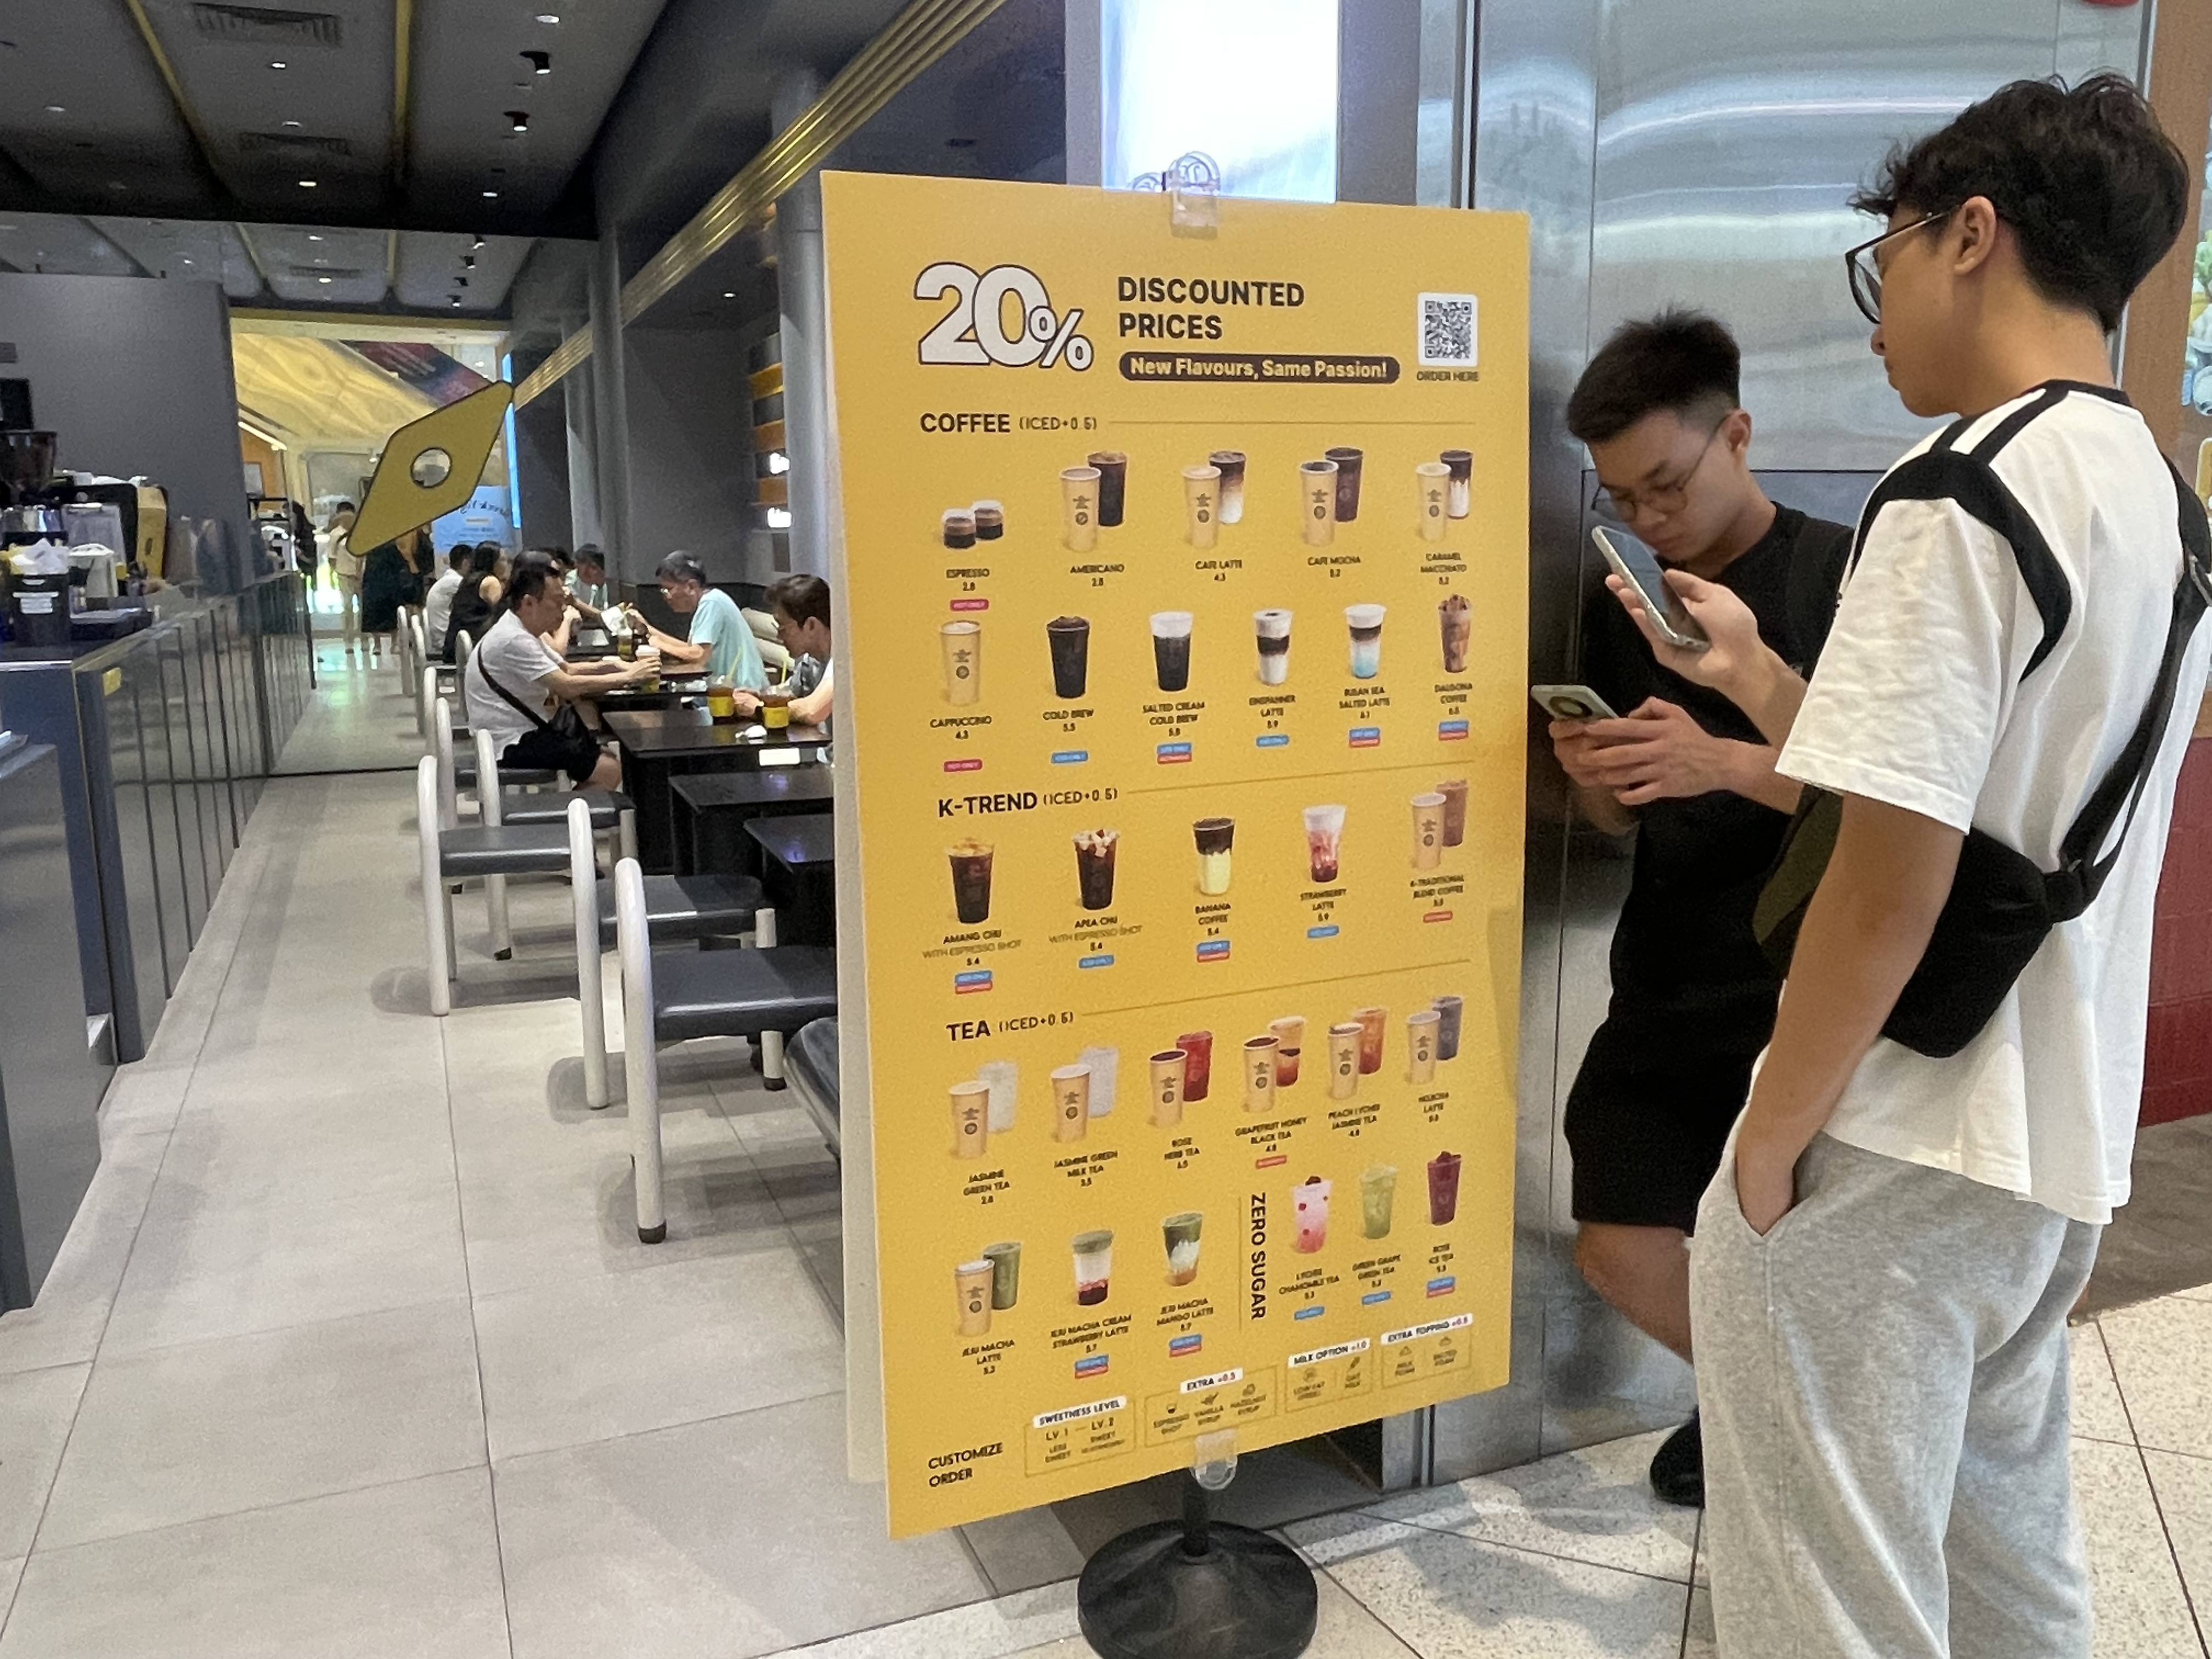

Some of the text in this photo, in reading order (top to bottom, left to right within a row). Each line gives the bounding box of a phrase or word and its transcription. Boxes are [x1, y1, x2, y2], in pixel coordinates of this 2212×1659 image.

[1118, 276, 1305, 307] DISCOUNTED
[913, 261, 1094, 372] 20%
[1118, 312, 1222, 341] PRICES
[1130, 359, 1387, 381] New Flavours, Same Passion!
[920, 413, 1011, 433] COFFEE
[938, 792, 1037, 817] K-TREND
[946, 1020, 990, 1041] TEA
[1251, 1193, 1266, 1320] ZERO SUGAR
[1316, 1346, 1348, 1360] OPTION
[1094, 1400, 1120, 1413] LEVEL
[928, 1442, 1003, 1469] CUSTOMIZE
[929, 1468, 973, 1487] ORDER
